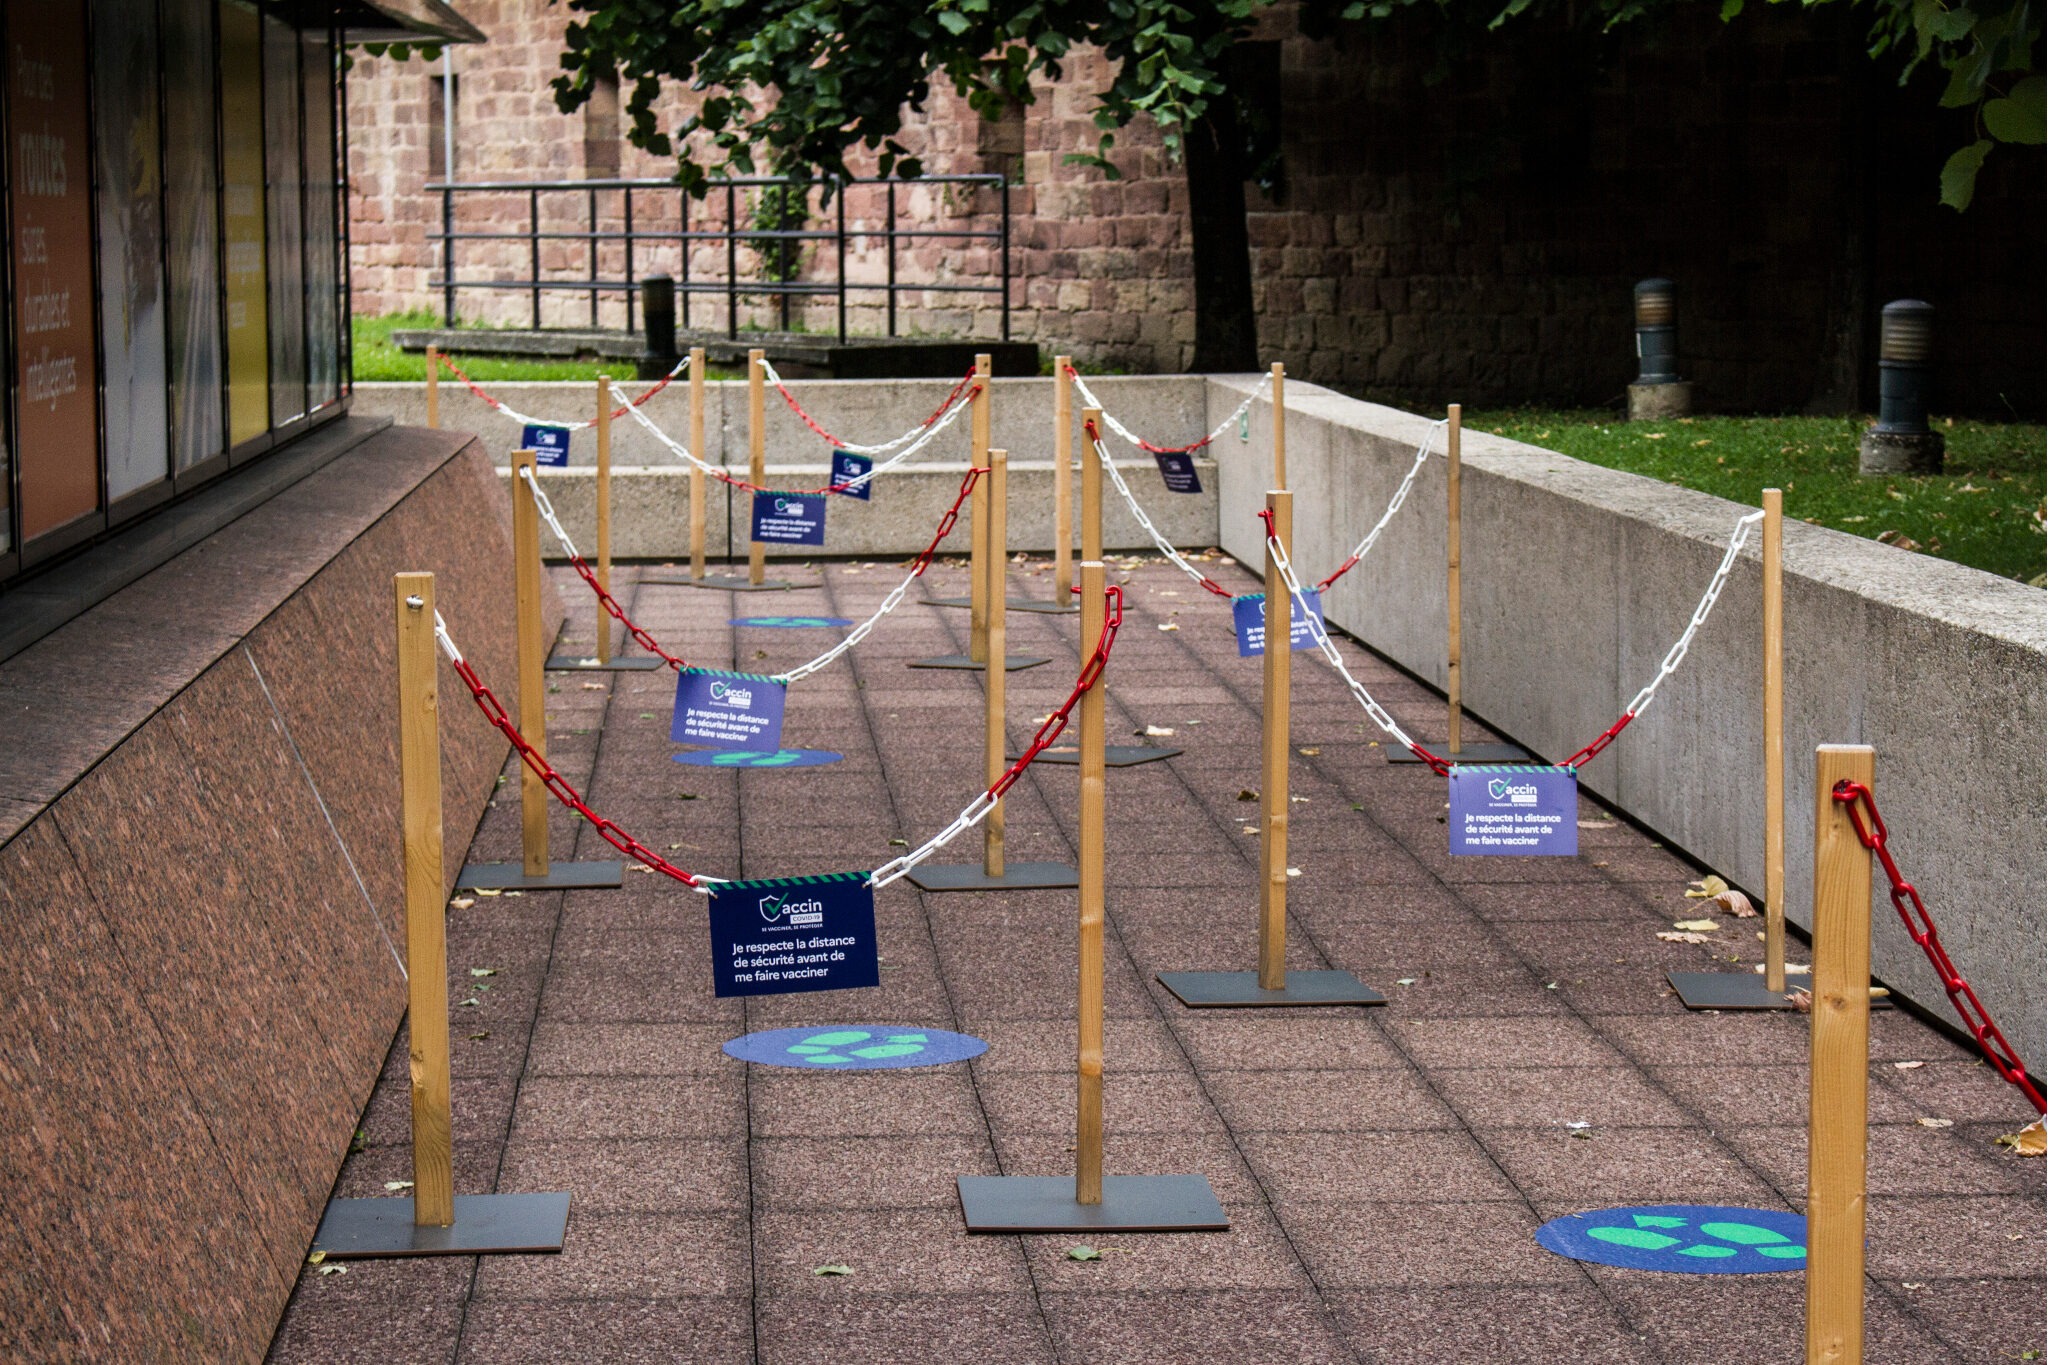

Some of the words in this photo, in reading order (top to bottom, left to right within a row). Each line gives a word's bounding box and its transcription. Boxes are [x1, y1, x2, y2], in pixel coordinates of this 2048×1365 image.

[19, 120, 67, 197] routes
[24, 278, 61, 334] durables
[61, 285, 71, 329] et
[25, 345, 77, 412] intelligentes
[687, 708, 695, 717] Je
[696, 710, 728, 719] respecte
[729, 712, 736, 721] la
[737, 714, 769, 725] distance
[686, 717, 696, 726] de
[728, 723, 749, 732] avant
[750, 725, 760, 734] de
[698, 728, 715, 738] faire
[716, 732, 748, 741] vacciner
[1465, 813, 1474, 823] Je
[1476, 814, 1513, 824] respecte
[1515, 813, 1523, 822] la
[1524, 813, 1561, 822] distance
[1465, 824, 1477, 834] de
[1479, 824, 1513, 834] sécurité
[1514, 826, 1539, 834] avant
[1540, 825, 1552, 834] de
[1465, 837, 1480, 845] me
[1481, 836, 1501, 845] faire
[1502, 836, 1539, 845] vacciner
[732, 943, 743, 955] Je
[746, 940, 794, 954] respecte
[796, 938, 806, 949] la
[808, 936, 855, 948] distance
[734, 957, 748, 968] de
[751, 954, 794, 967] sécurité
[797, 952, 828, 964] avant
[830, 950, 845, 960] de
[735, 973, 752, 982] me
[755, 970, 780, 981] faire
[782, 967, 828, 979] vacciner
